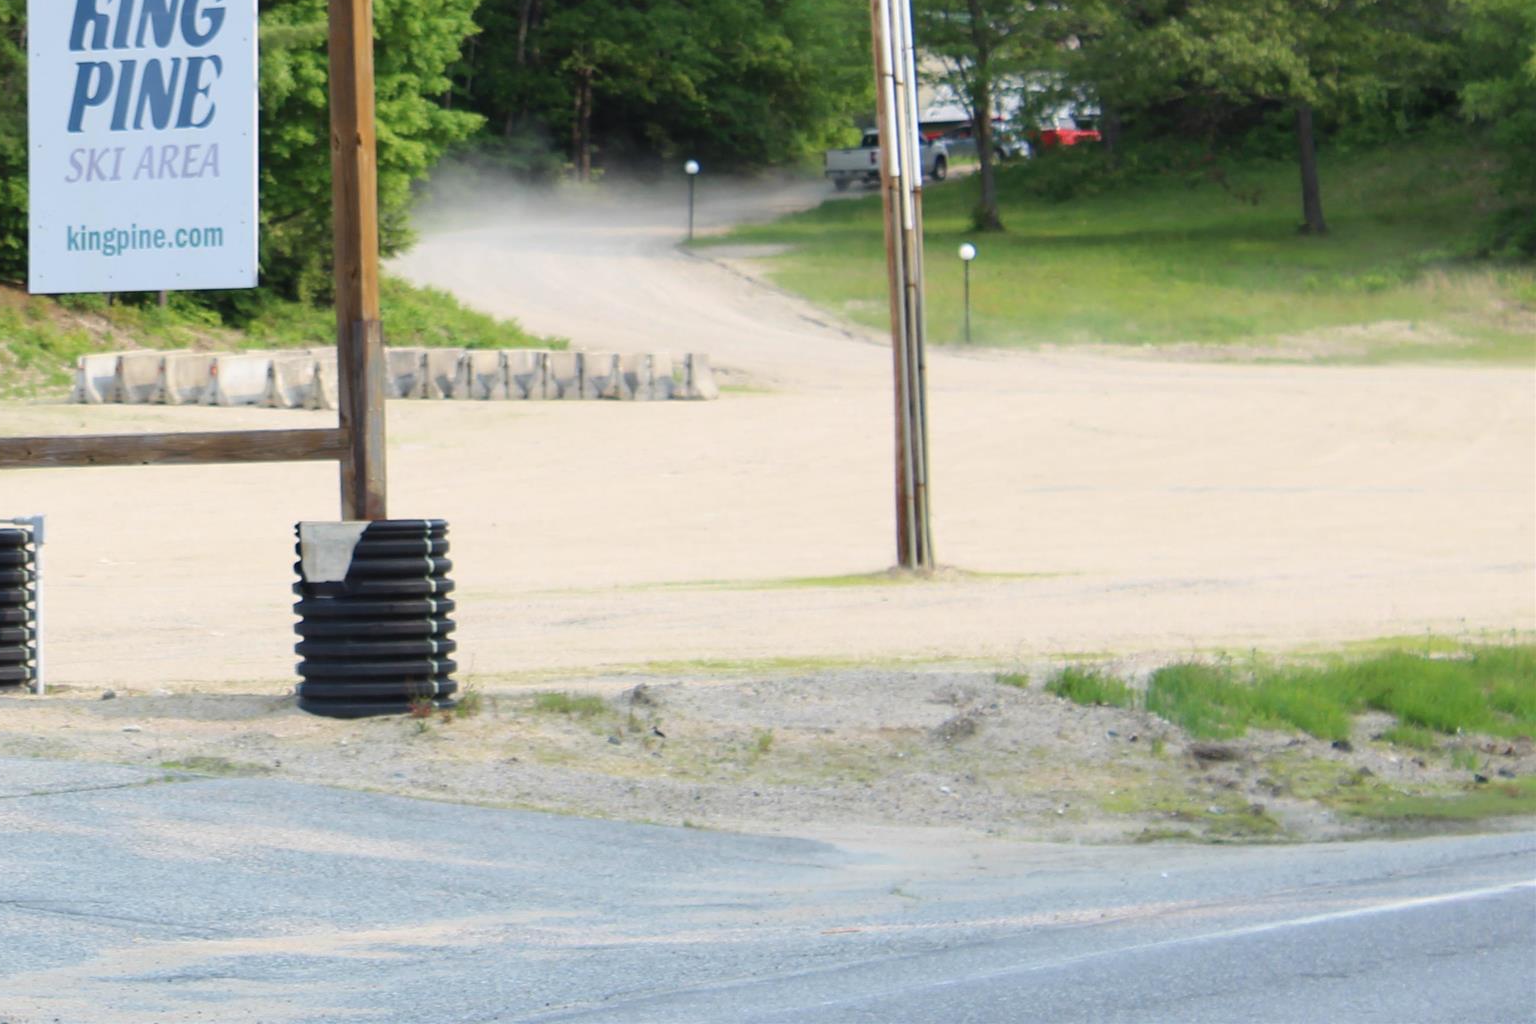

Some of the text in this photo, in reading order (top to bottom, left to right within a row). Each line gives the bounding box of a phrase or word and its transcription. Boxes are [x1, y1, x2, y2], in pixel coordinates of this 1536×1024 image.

[67, 55, 223, 133] PINE
[65, 142, 221, 183] SKI AREA
[66, 223, 223, 256] kingpine.com
